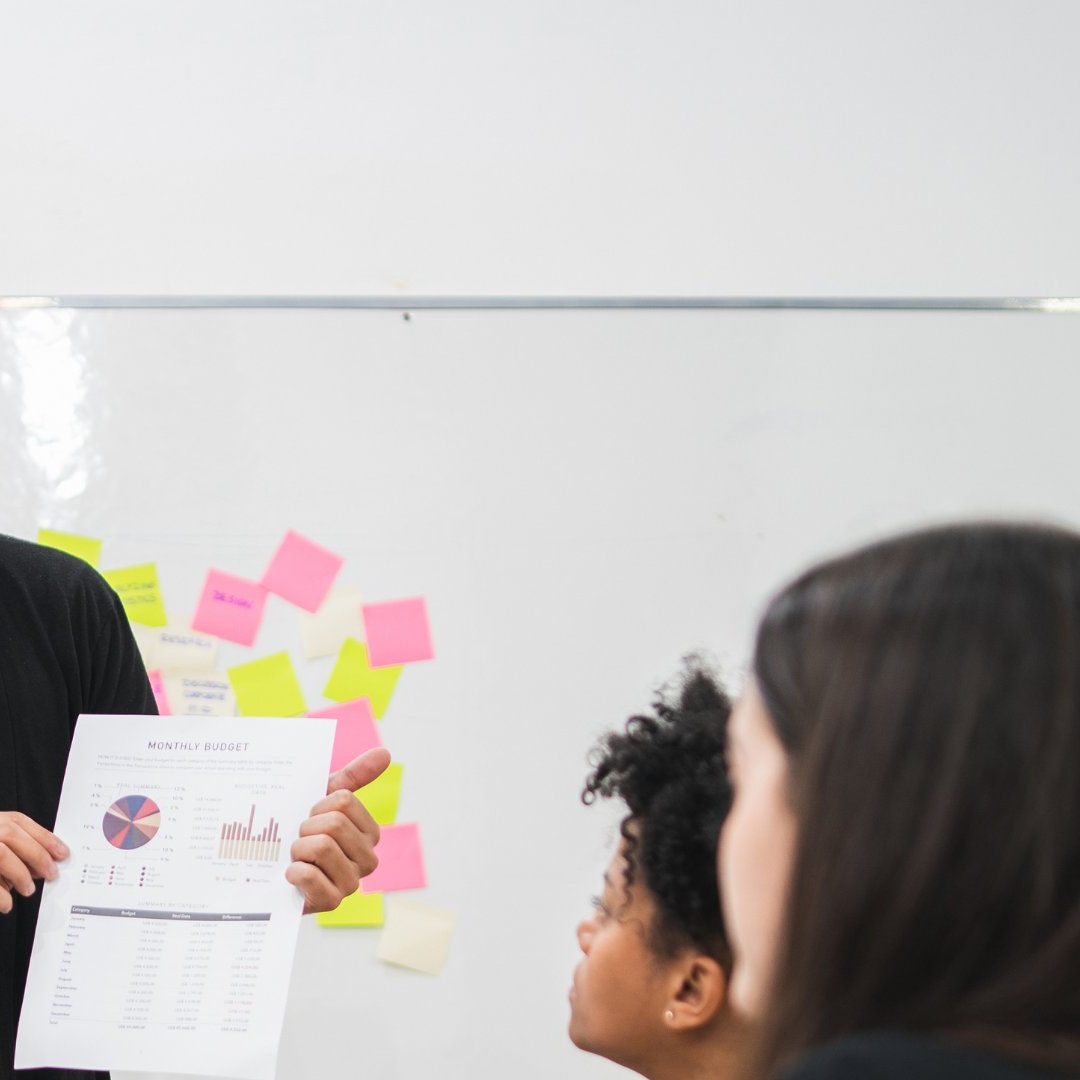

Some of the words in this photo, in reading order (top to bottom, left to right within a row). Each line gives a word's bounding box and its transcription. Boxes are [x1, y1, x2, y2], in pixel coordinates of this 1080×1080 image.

[212, 589, 253, 609] DESIGN
[147, 741, 200, 751] MONTHLY
[204, 742, 249, 751] BUDGET
